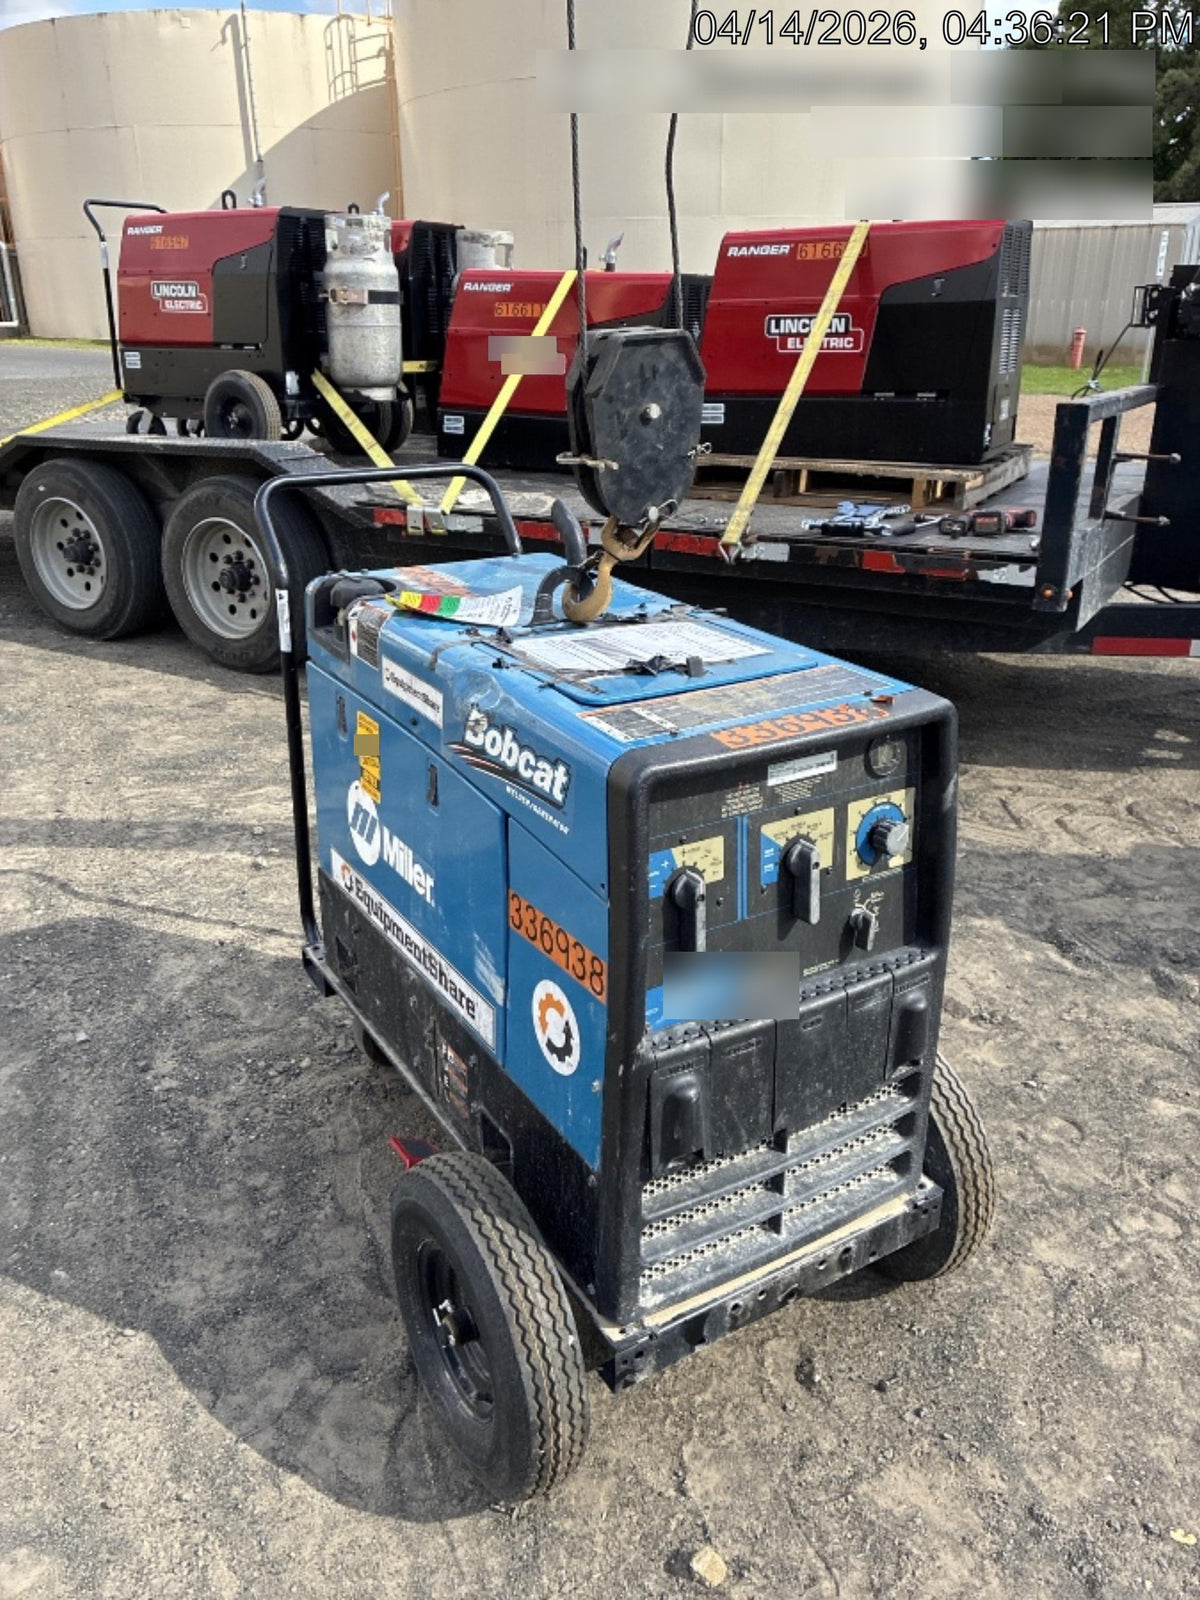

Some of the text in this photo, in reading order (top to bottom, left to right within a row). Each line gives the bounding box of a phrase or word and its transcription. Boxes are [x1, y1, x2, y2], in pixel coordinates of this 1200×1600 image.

[127, 225, 164, 236] RANGER
[727, 244, 791, 257] RANGER
[153, 283, 197, 298] LINCOLN
[463, 282, 512, 293] RANGER
[164, 299, 204, 311] ELECTRIC
[769, 317, 846, 334] LINCN
[786, 337, 854, 350] ELTRIC
[464, 709, 568, 802] Bobcat
[382, 825, 434, 905] Miller
[354, 876, 476, 1020] EquipmentShare
[510, 893, 605, 997] 336938
